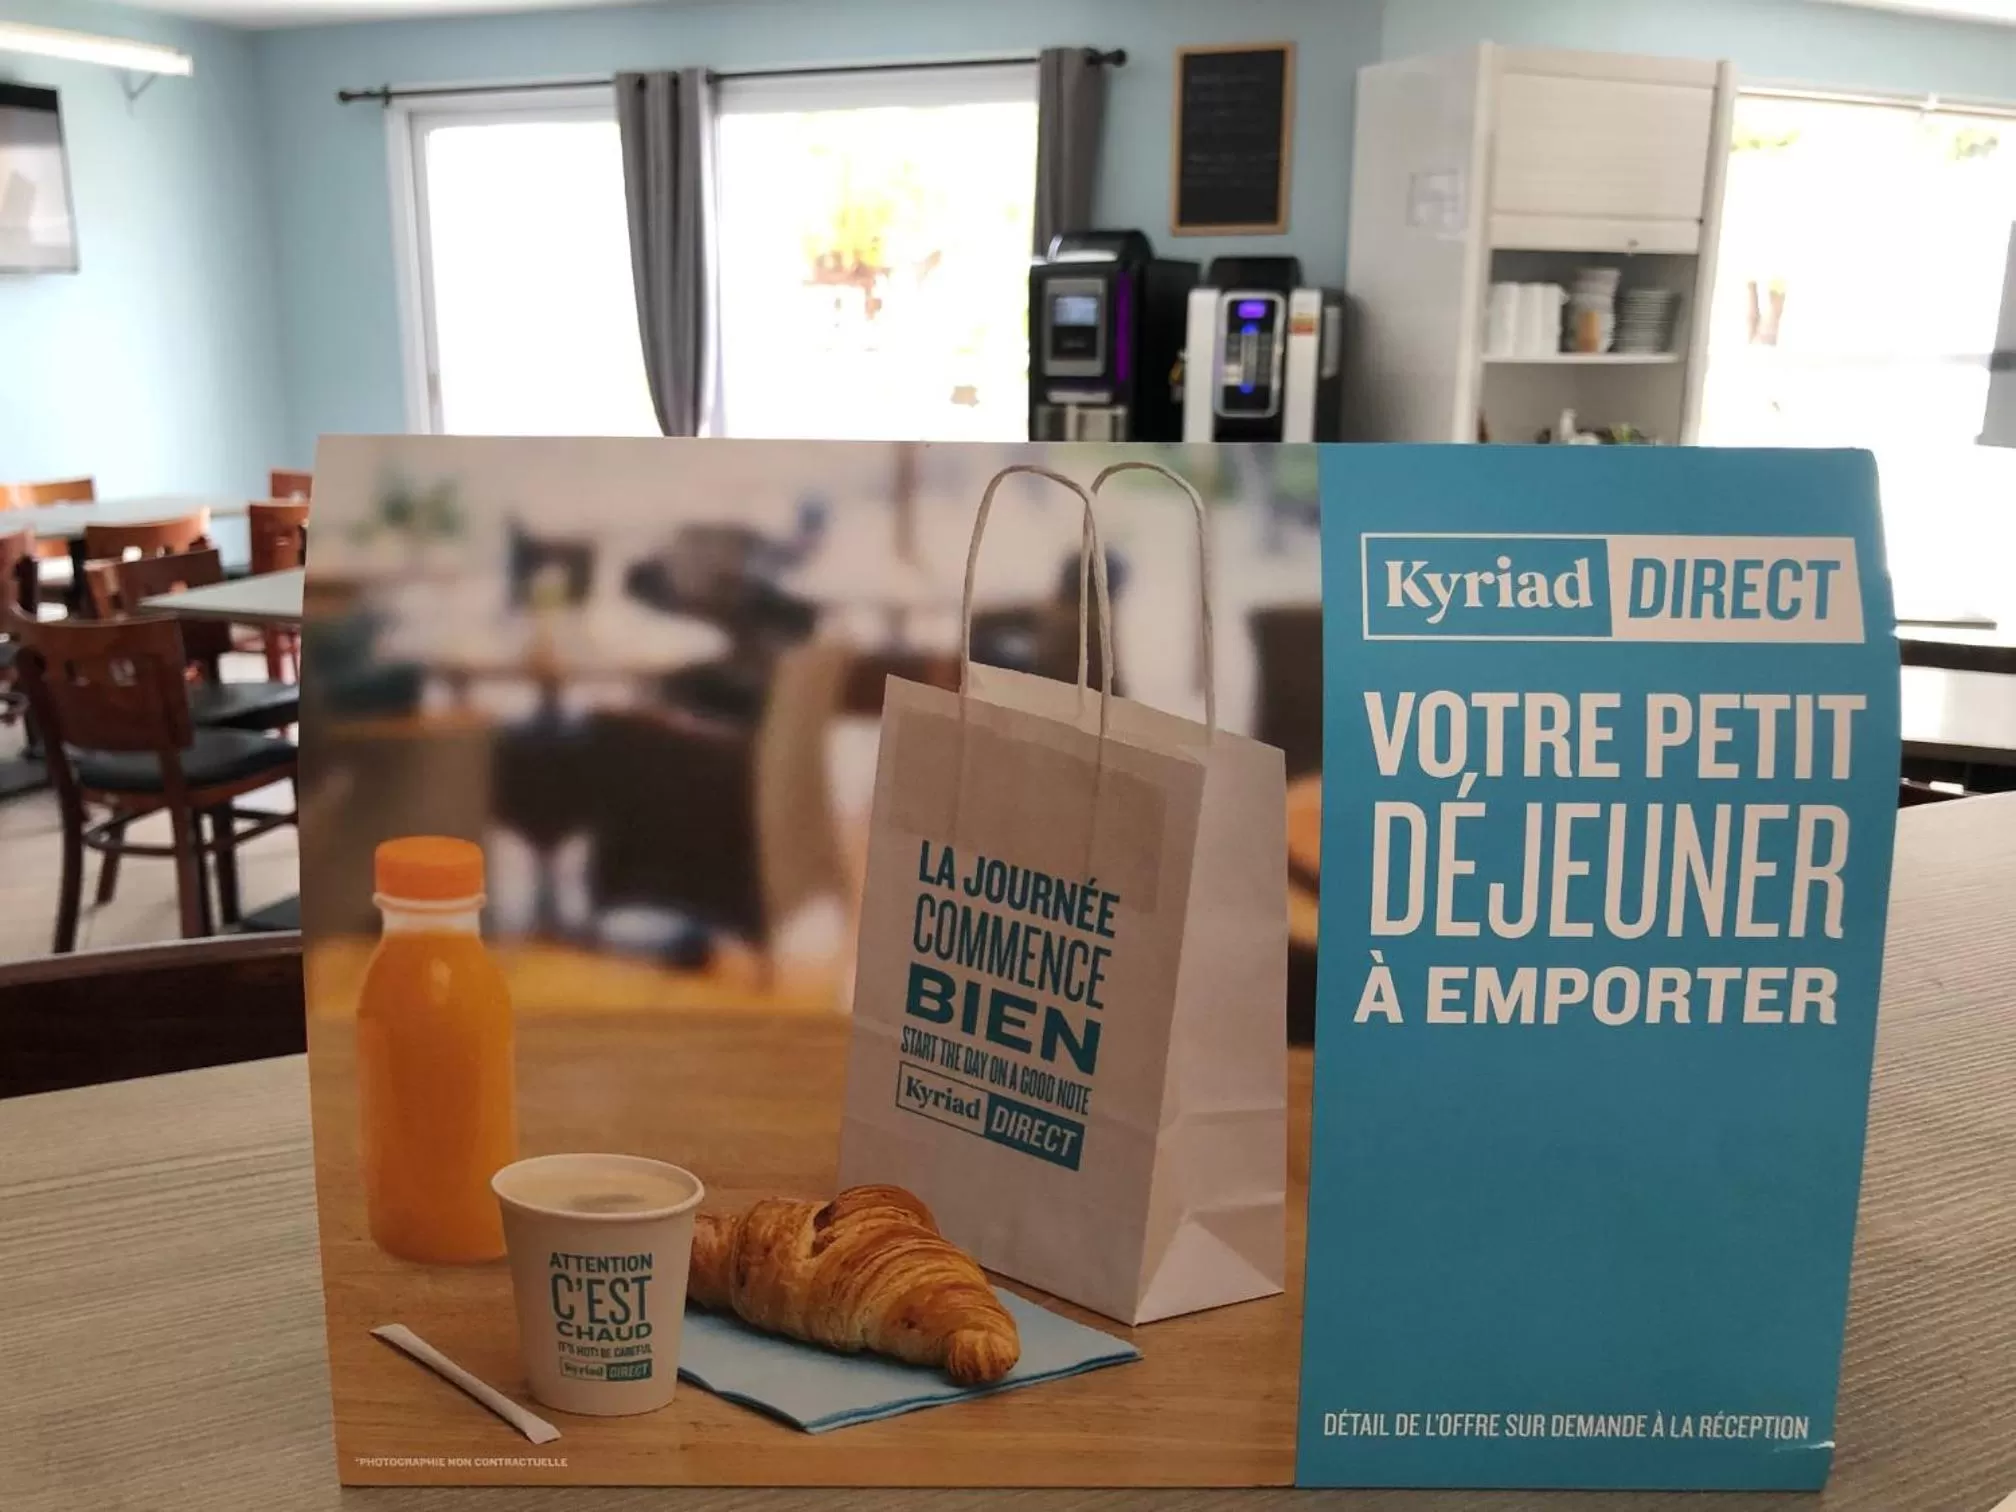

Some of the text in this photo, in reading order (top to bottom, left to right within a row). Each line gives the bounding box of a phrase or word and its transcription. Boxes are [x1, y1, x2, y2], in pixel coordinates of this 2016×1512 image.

[1386, 555, 1841, 624] Kyriad DIRECT
[1363, 691, 1867, 780] VOTRE PETIT
[919, 840, 1120, 938] LA JOURNÉE
[1370, 772, 1850, 940] DÉJEUNER
[913, 893, 1111, 1009] COMMENCE
[1353, 949, 1838, 1026] À EMPORTER
[906, 962, 1101, 1076] BIEN
[901, 1025, 1093, 1115] START THE DAY ON A GOOD NOTE
[906, 1075, 1078, 1157] Kyriad DIRECT
[550, 1252, 653, 1273] ATTENTION
[551, 1273, 652, 1325] C'EST
[556, 1321, 653, 1341] CHAUD
[608, 1362, 649, 1378] DIRECT
[448, 1457, 471, 1468] NON
[475, 1457, 568, 1468] CONTRACTUELLE
[1324, 1408, 1809, 1440] DÉTAIL DE L'OFFRE SUR DEMANDE À LA RÉCEPTION
